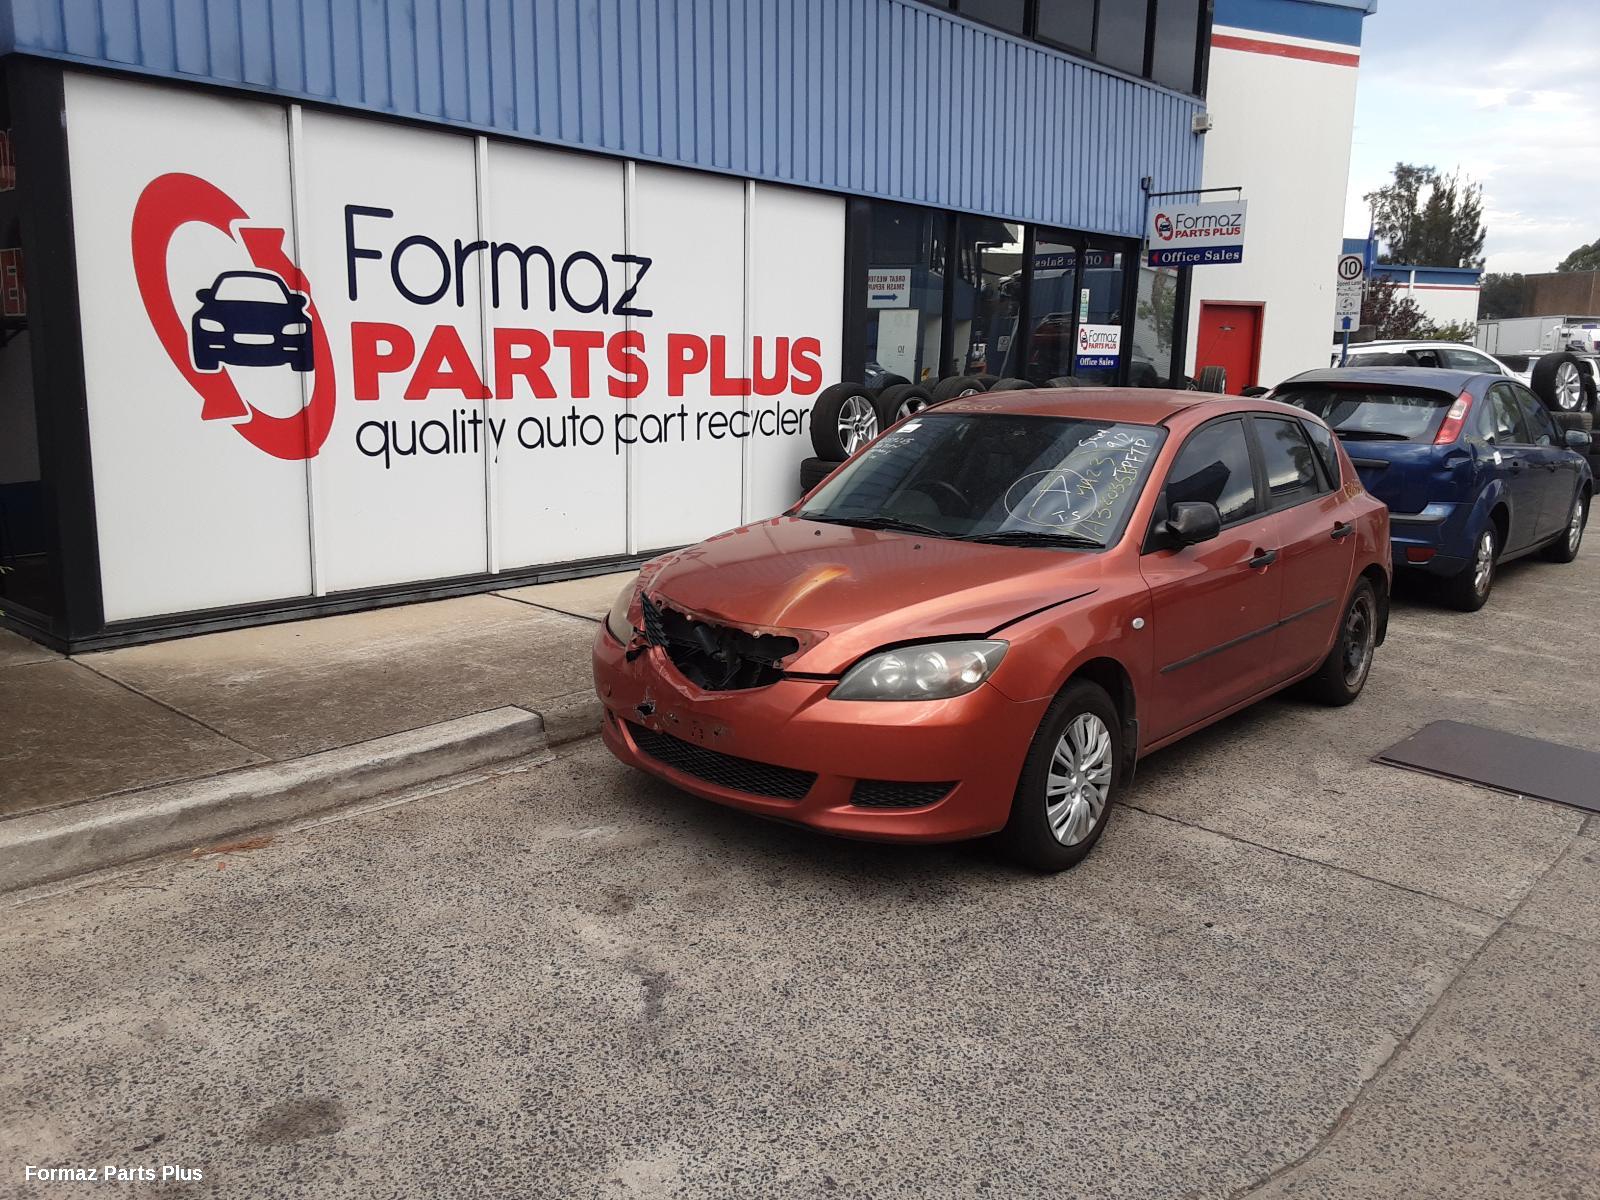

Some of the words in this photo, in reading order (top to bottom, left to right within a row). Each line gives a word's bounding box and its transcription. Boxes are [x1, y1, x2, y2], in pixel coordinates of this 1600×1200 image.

[1175, 213, 1243, 229] Formaz
[1175, 229, 1211, 238] PARTS
[1212, 227, 1241, 236] PLUS
[344, 204, 653, 318] Formaz
[1161, 251, 1201, 263] Office
[1204, 250, 1240, 261] Sales
[1344, 261, 1358, 275] 10
[1088, 330, 1118, 343] Formaz
[1088, 342, 1105, 350] PARTS
[350, 321, 649, 401] PARTS
[666, 332, 823, 397] PLUS
[1079, 357, 1098, 366] Office
[1098, 357, 1114, 366] Sales
[355, 408, 507, 470] quality
[517, 405, 605, 450] auto
[614, 403, 689, 455] part
[1032, 474, 1072, 510] A
